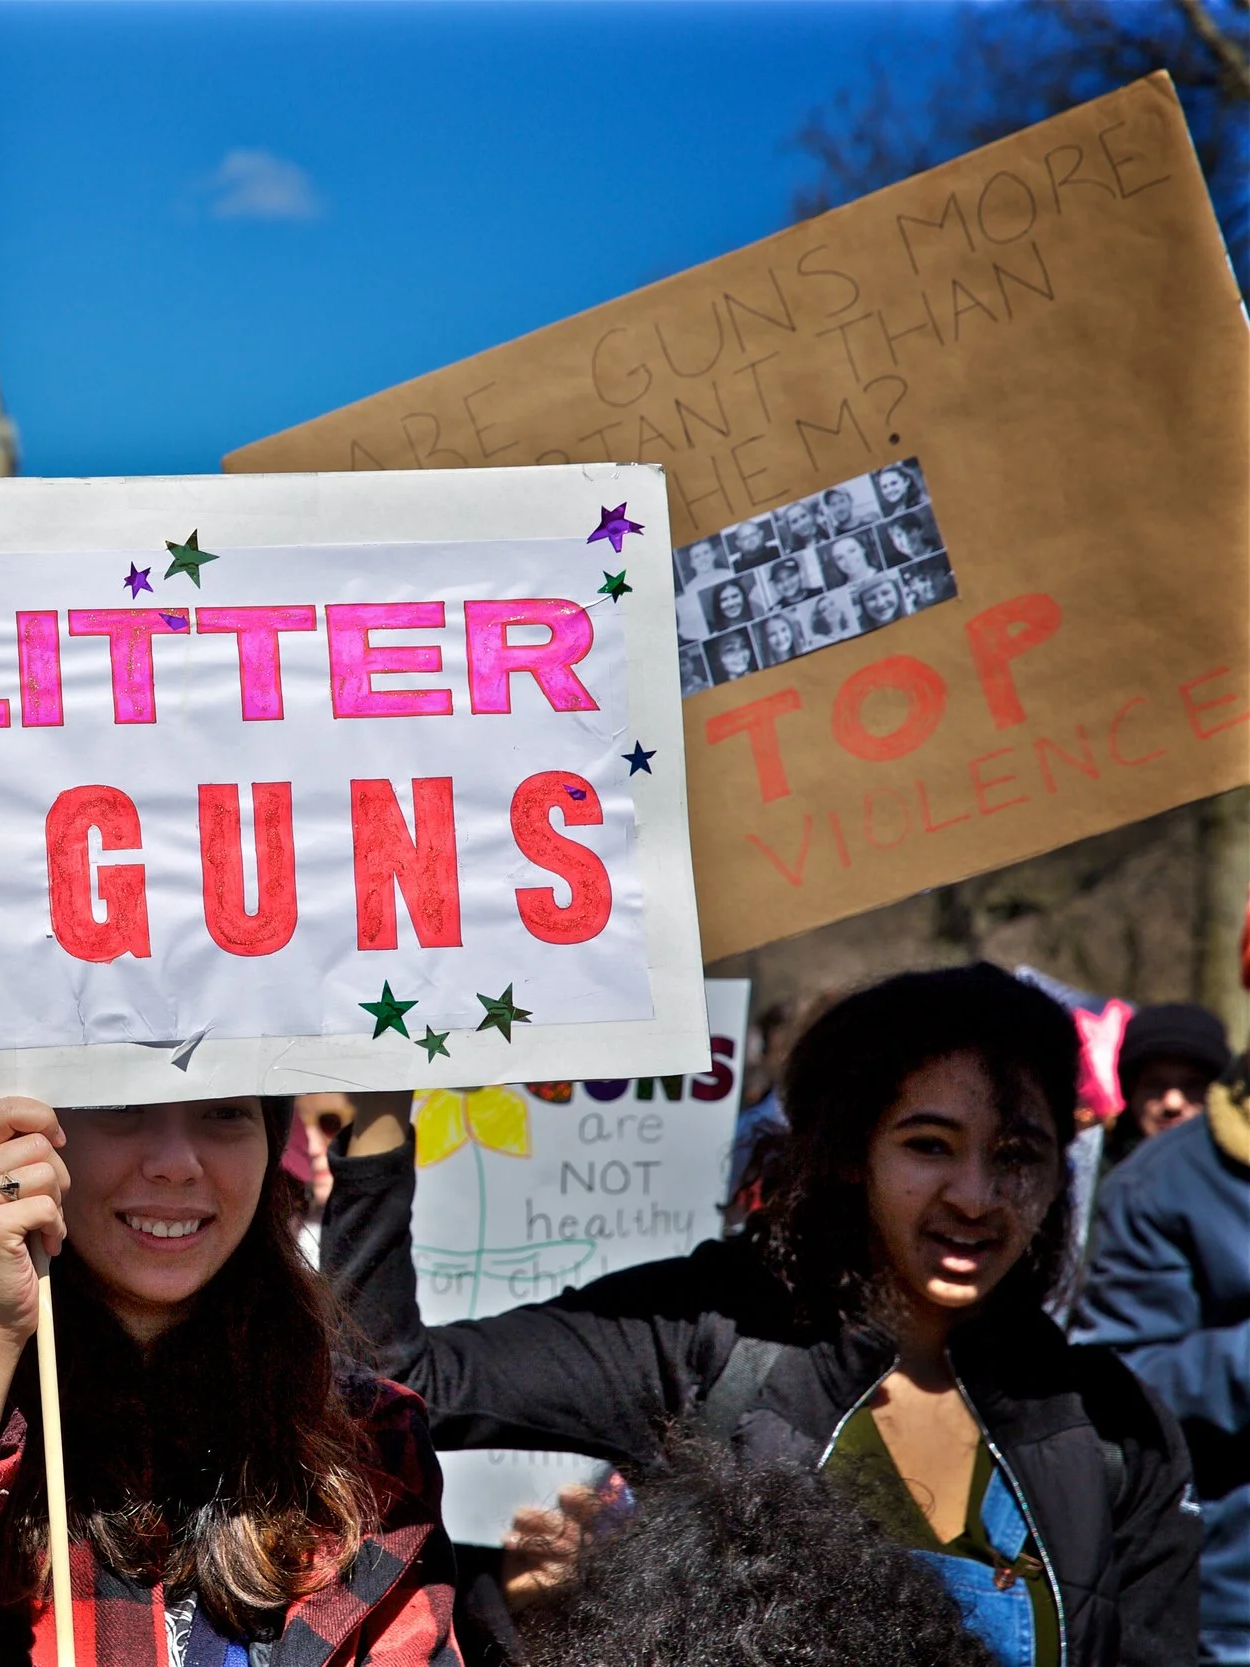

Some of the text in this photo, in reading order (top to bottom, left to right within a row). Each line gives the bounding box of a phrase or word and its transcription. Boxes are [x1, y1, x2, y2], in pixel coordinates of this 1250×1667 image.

[591, 244, 860, 408] GUNS
[896, 121, 1173, 276] MORE
[815, 241, 1055, 384] THAN
[744, 666, 1250, 887] VIOLENCE
[45, 770, 612, 964] GUNS
[559, 1160, 663, 1197] NOT
[578, 1111, 664, 1146] are
[525, 1197, 696, 1254] healthy
